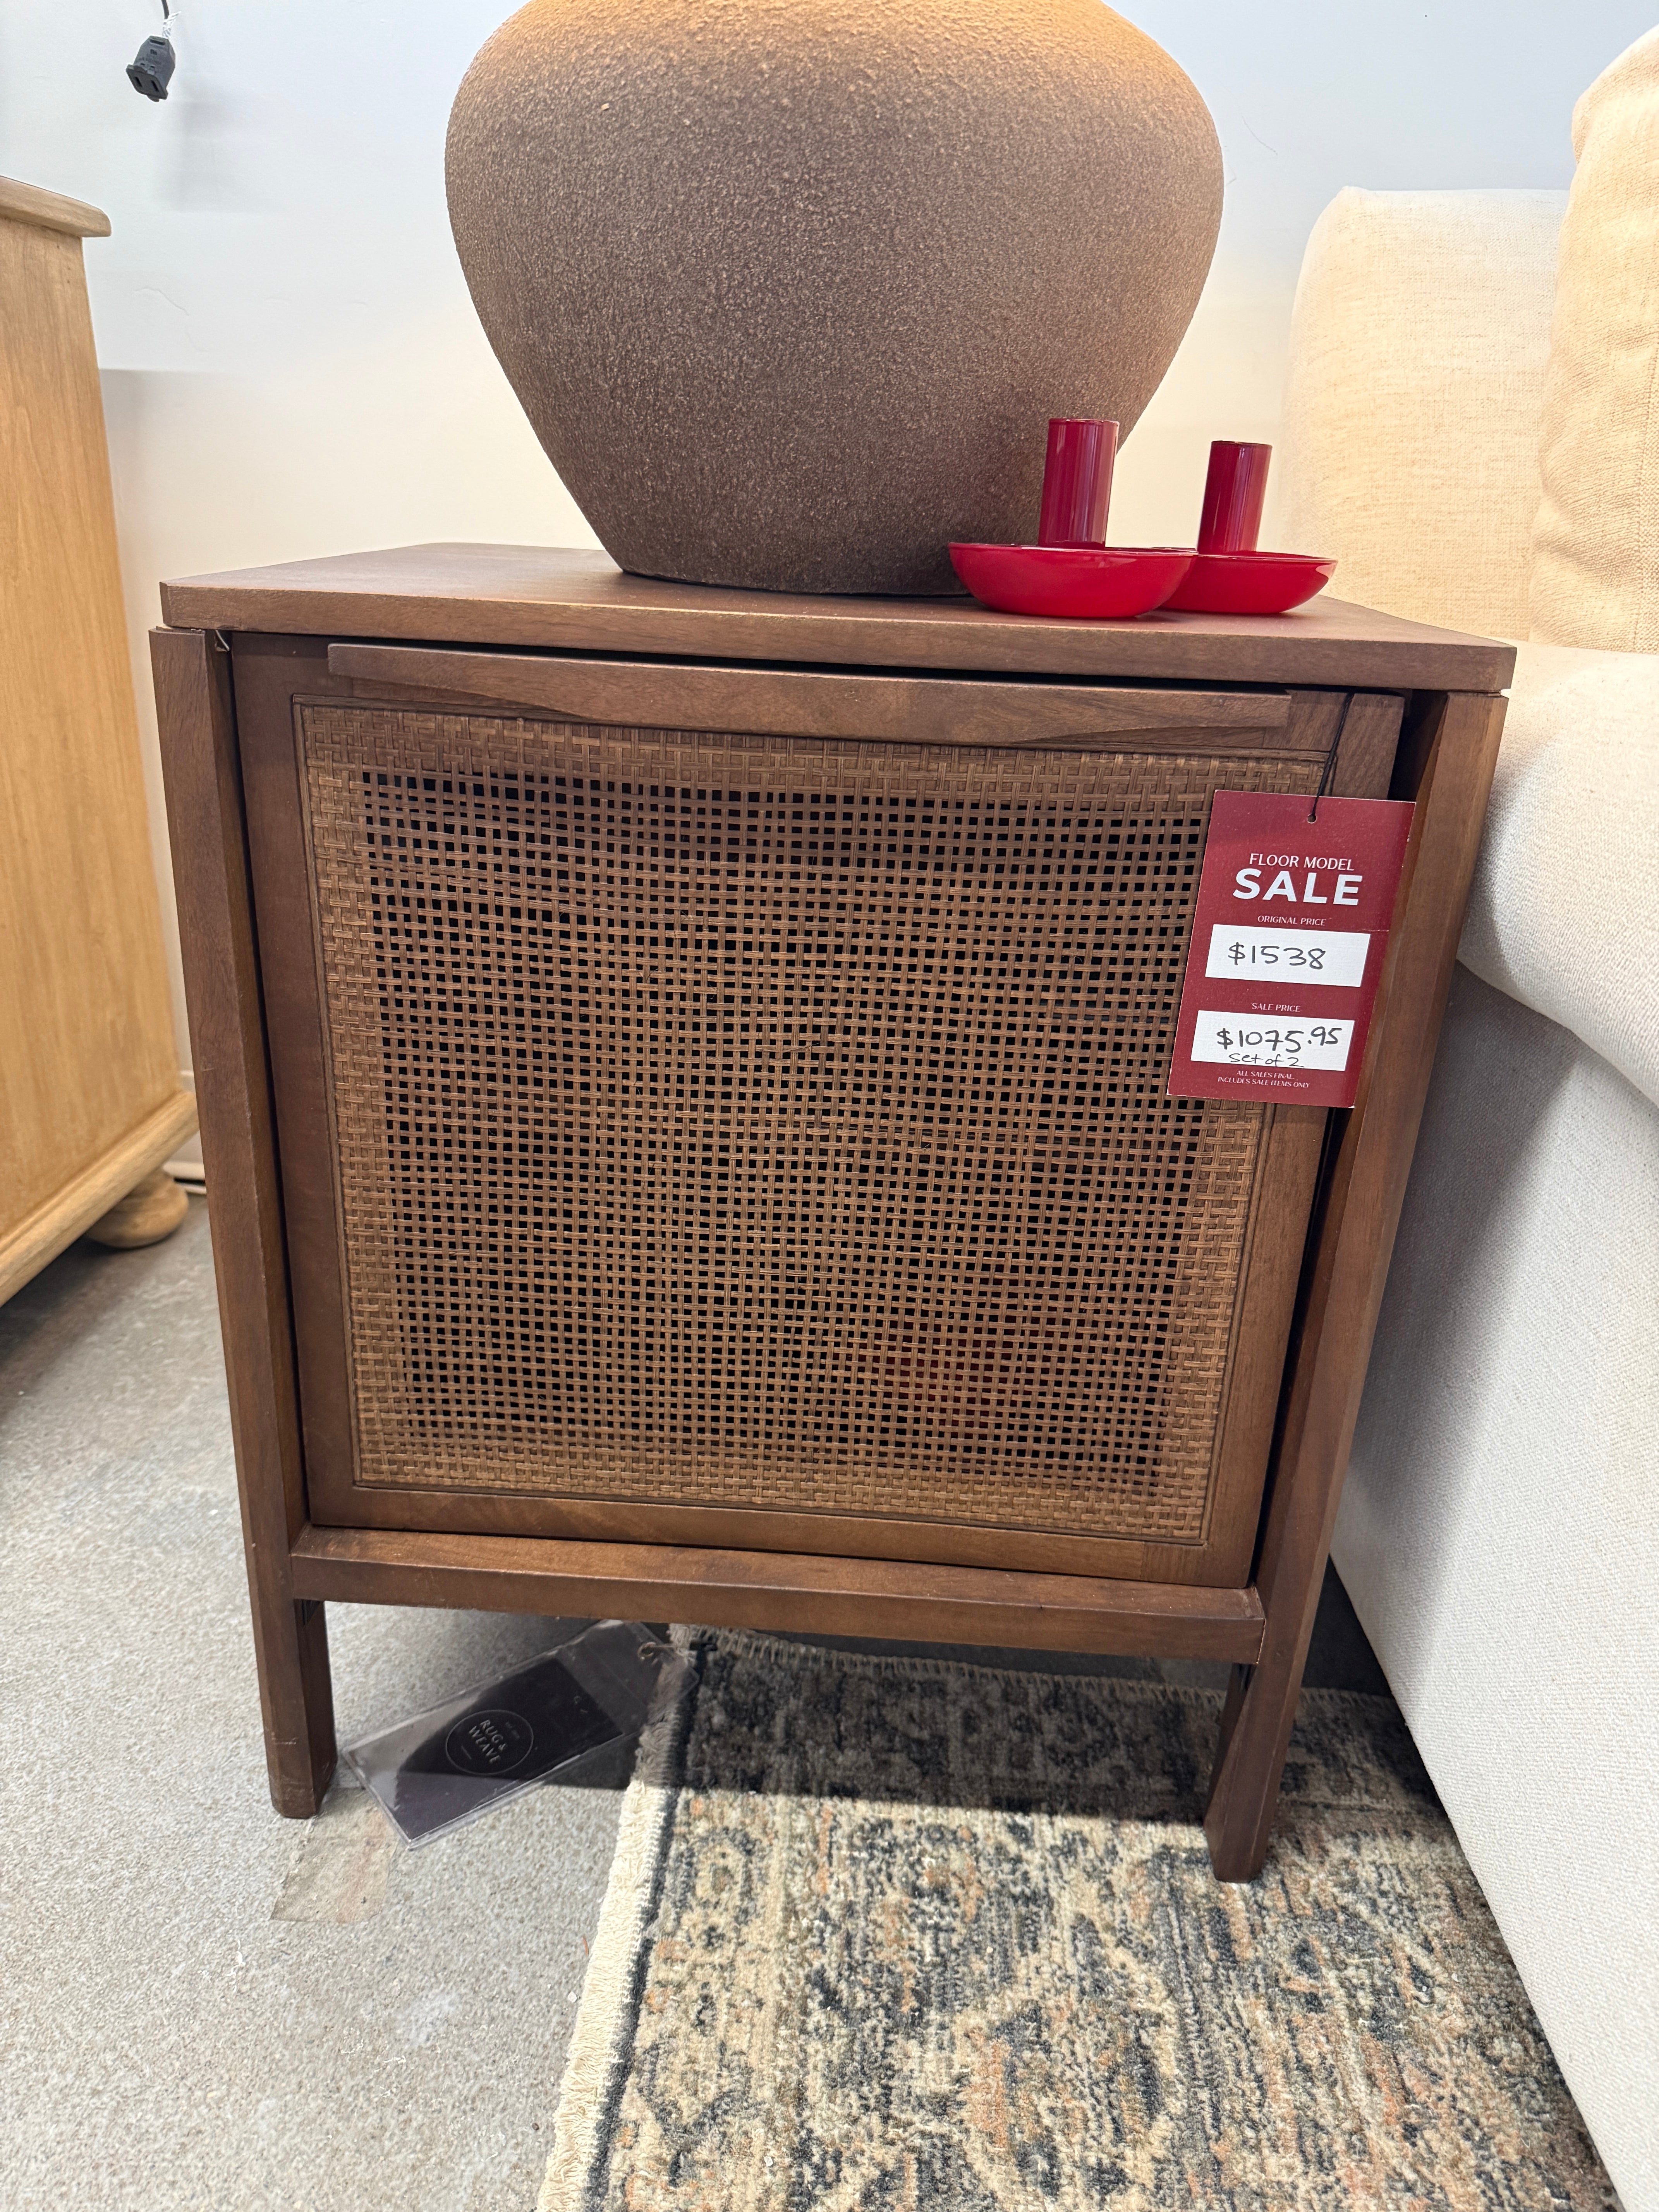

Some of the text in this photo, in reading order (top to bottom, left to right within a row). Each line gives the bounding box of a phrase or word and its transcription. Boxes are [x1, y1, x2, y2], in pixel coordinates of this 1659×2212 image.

[1249, 853, 1354, 871] FLOOR MODEL
[1233, 868, 1362, 905] SALE
[1258, 915, 1326, 926] ORIGINAL PRICE
[1228, 942, 1326, 970] $1538
[1252, 1003, 1273, 1011] SALE
[1216, 1026, 1342, 1053] $1075.95
[1265, 1054, 1284, 1067] of
[1287, 1057, 1305, 1068] 2
[480, 1719, 503, 1744] RUG
[468, 1726, 501, 1764] WEAVE
